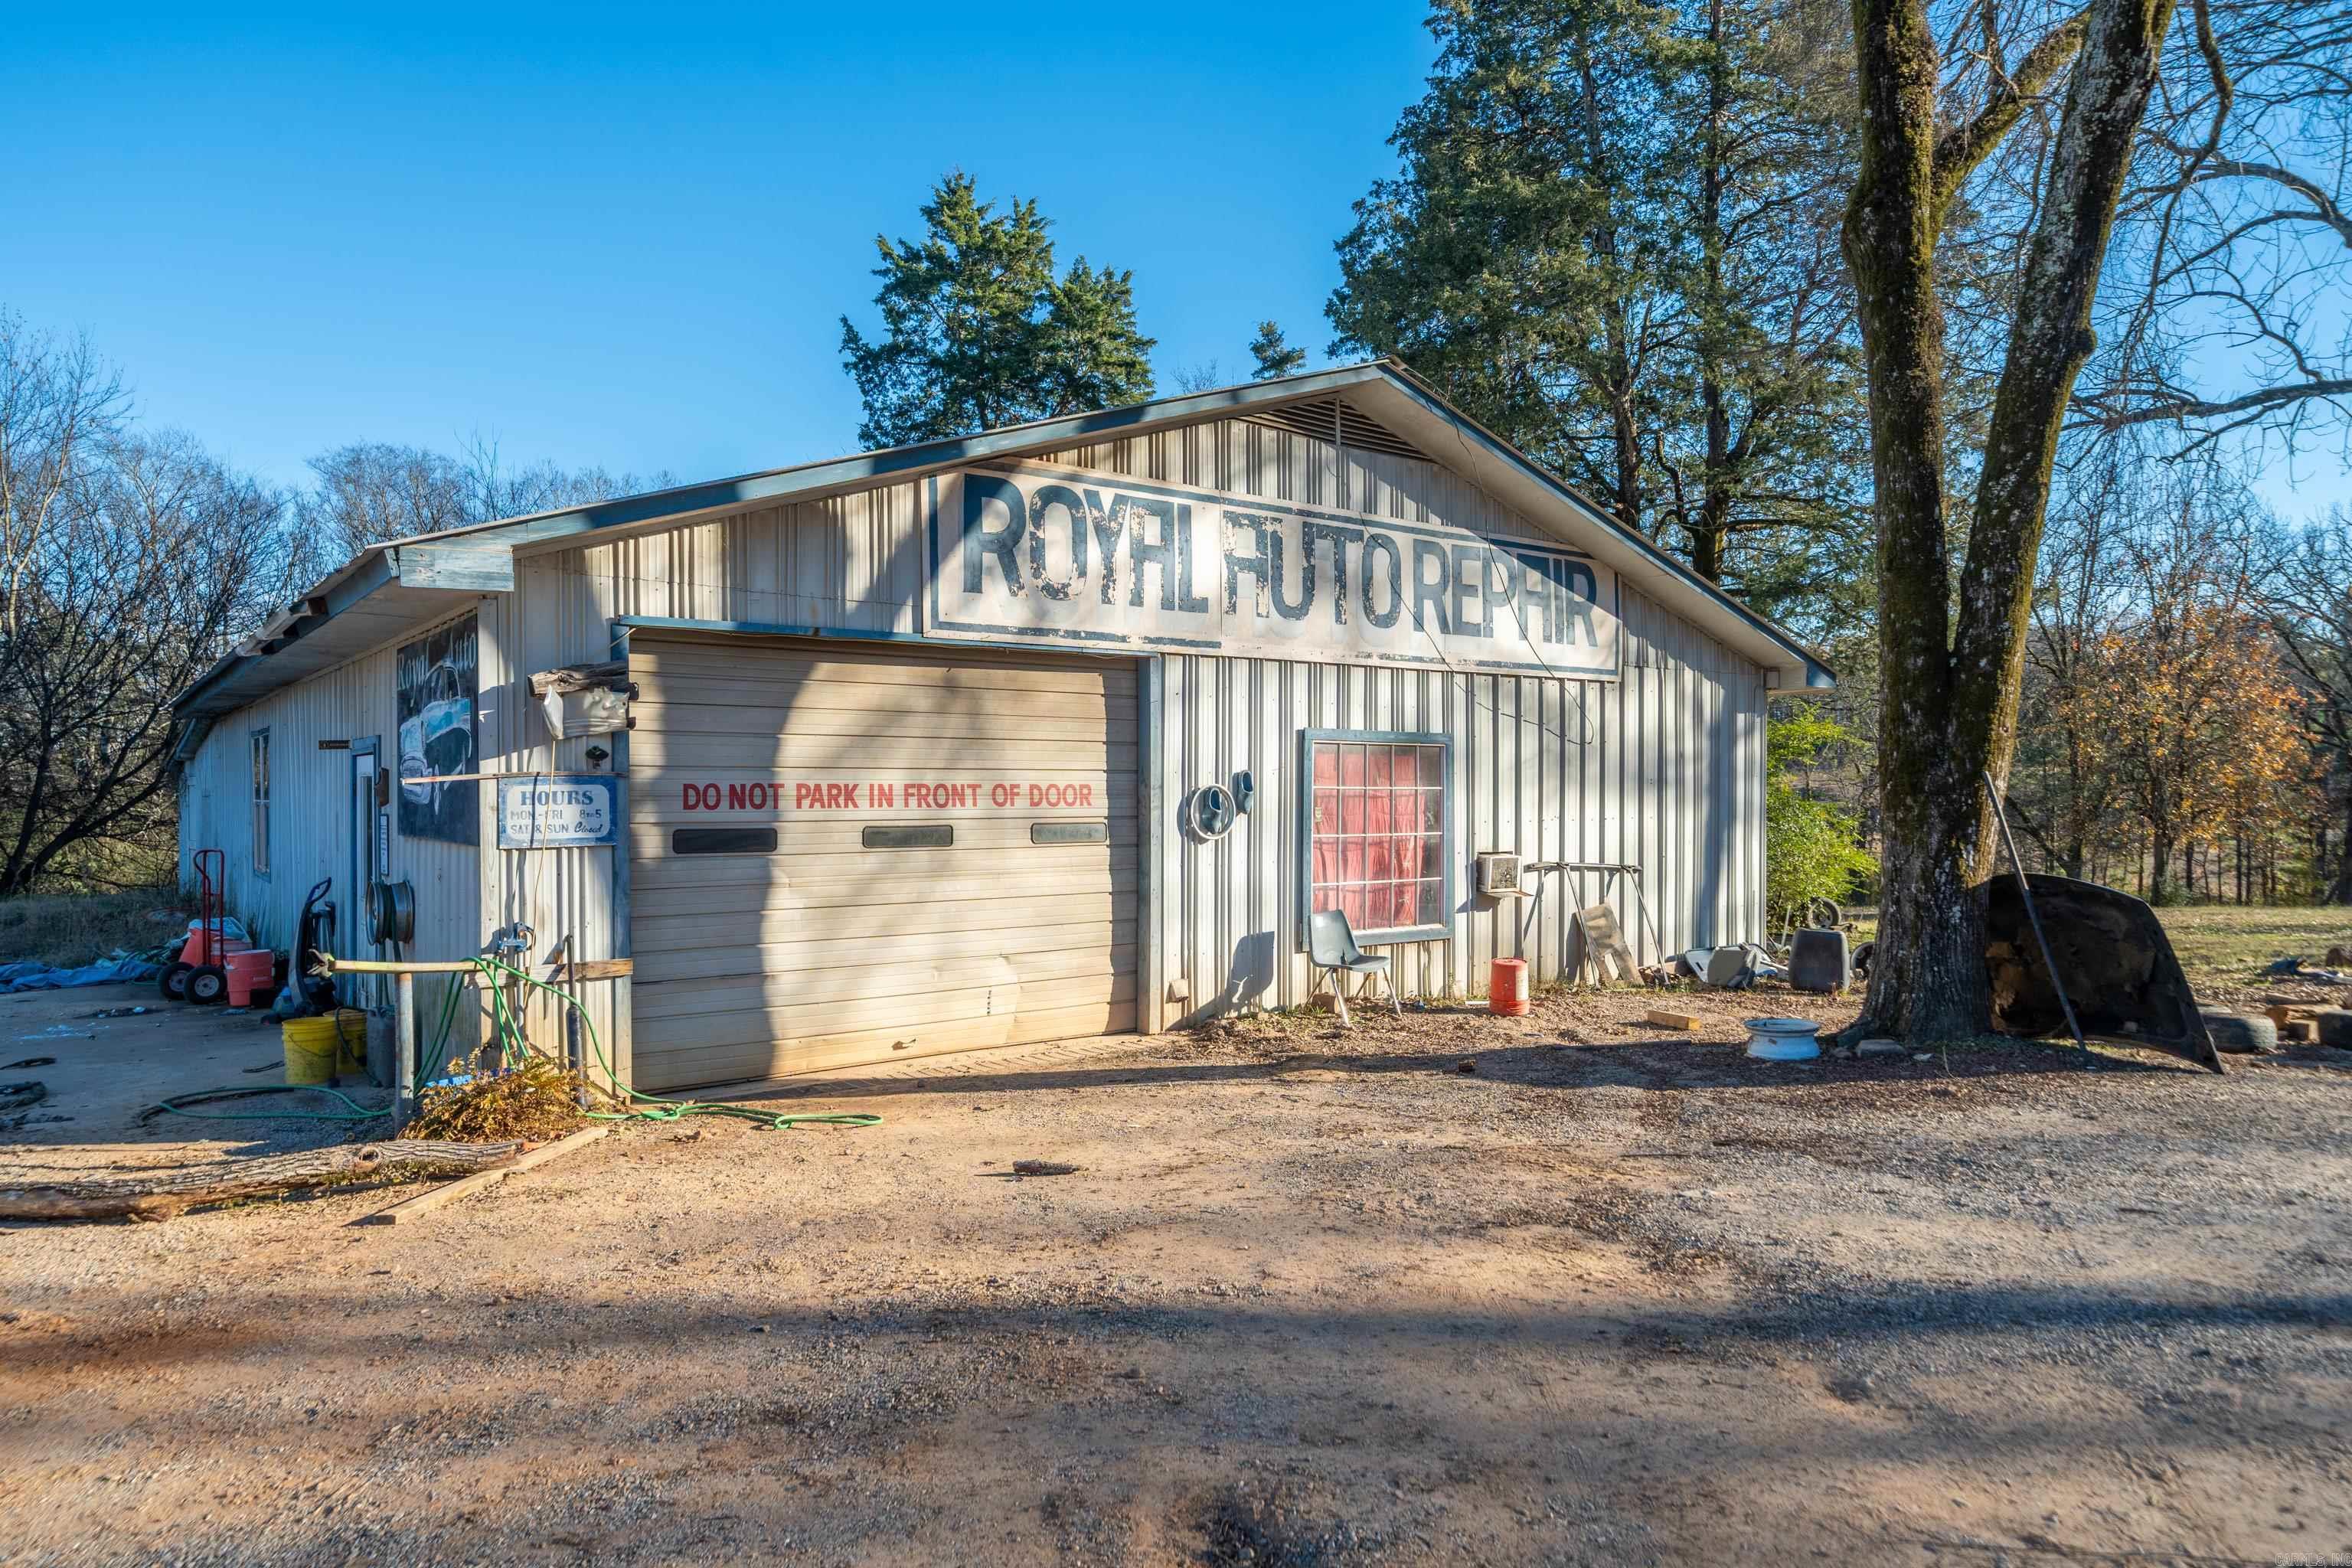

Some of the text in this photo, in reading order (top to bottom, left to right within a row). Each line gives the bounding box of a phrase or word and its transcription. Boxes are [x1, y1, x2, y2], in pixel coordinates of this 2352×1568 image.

[962, 473, 1598, 648] ROYAL AUTO REPAIR
[397, 630, 477, 707] Royal Auto
[520, 790, 594, 805] HOURS
[682, 782, 1093, 811] DO NOT PARK IN FRONT OF DOOR
[510, 821, 603, 835] SAT & SUN Closed
